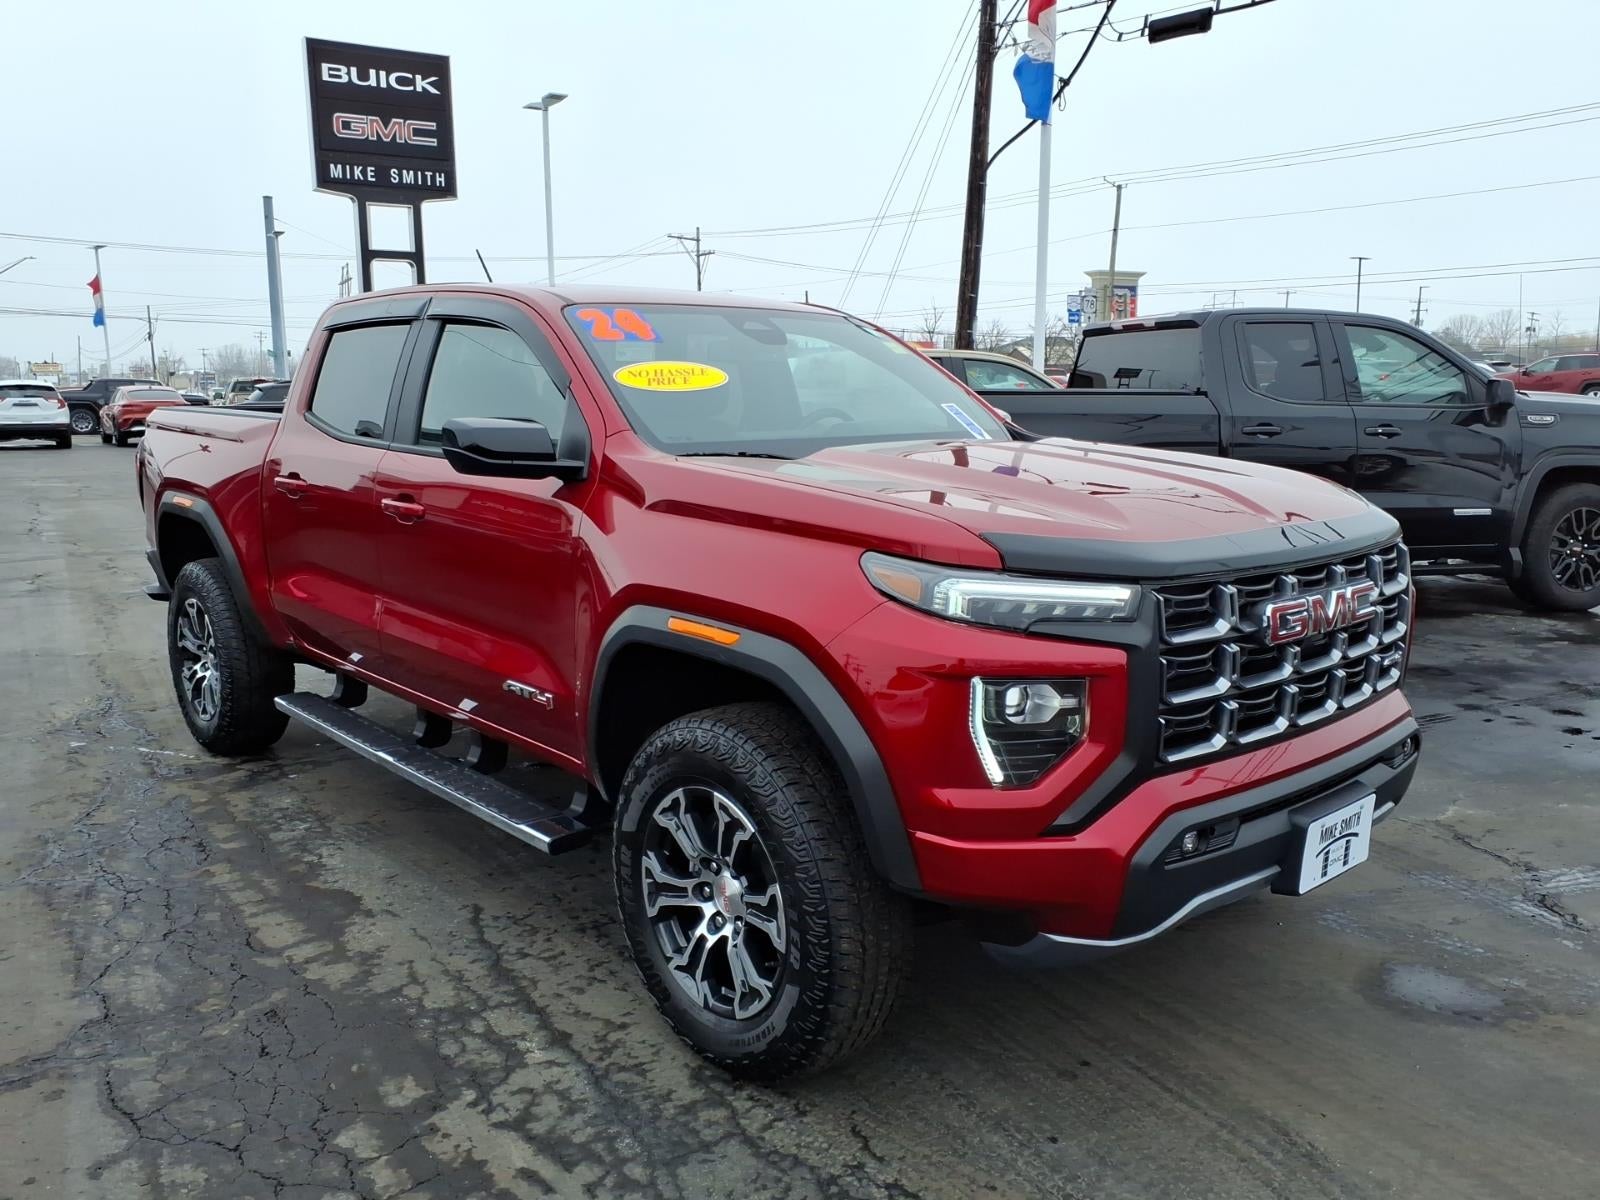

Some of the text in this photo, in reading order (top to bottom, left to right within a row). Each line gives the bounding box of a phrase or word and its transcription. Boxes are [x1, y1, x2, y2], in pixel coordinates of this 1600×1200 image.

[320, 62, 441, 95] BUICK
[333, 112, 438, 147] GMC
[329, 163, 446, 187] MIKE SMITH
[1084, 299, 1095, 309] 78
[575, 307, 657, 342] 24
[627, 367, 709, 379] NO HASSLE
[647, 376, 691, 387] PRICE
[1264, 580, 1379, 647] GMC
[1319, 810, 1362, 845] MIKE SMITH
